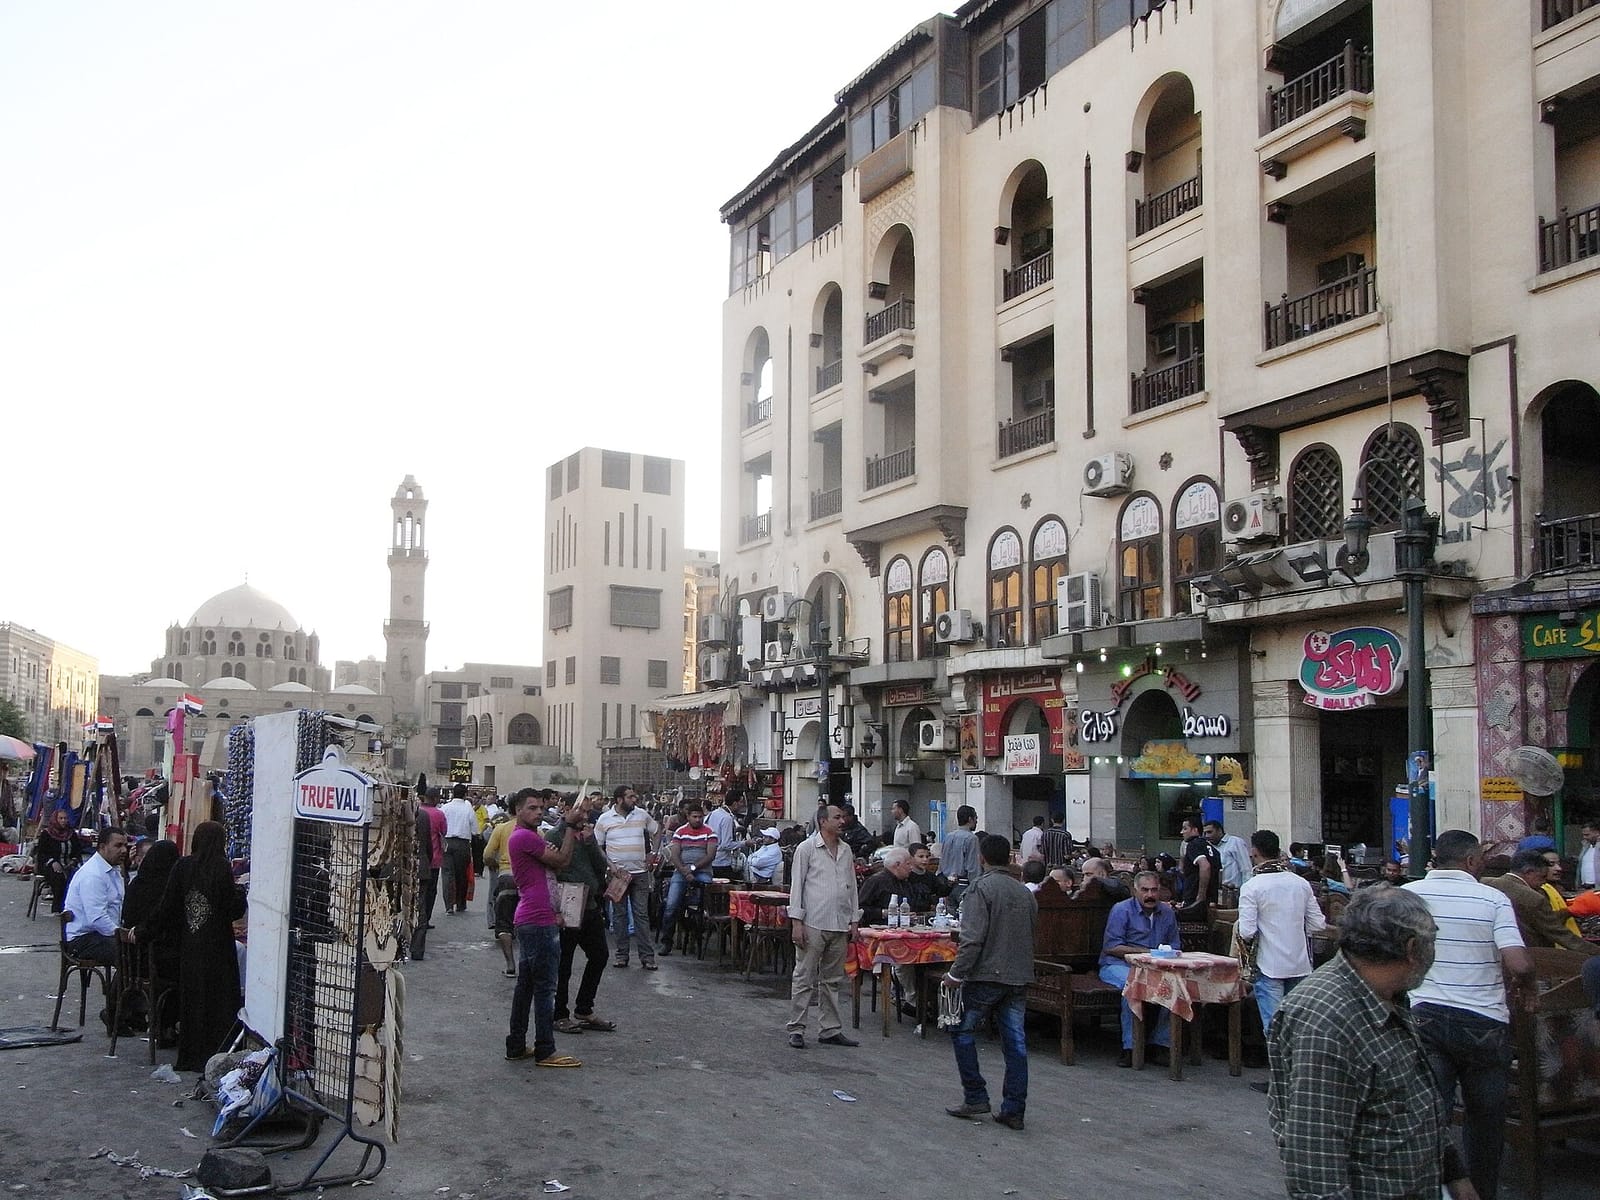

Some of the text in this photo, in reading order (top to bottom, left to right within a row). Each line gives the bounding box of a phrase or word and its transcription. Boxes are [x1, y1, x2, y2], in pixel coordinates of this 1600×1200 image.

[1533, 624, 1567, 647] CAFE
[1323, 693, 1366, 710] MALKY
[1081, 708, 1117, 742] كوارع
[1182, 707, 1229, 738] مسمط
[1007, 737, 1022, 752] فقط
[301, 784, 361, 812] TRUEVAL
